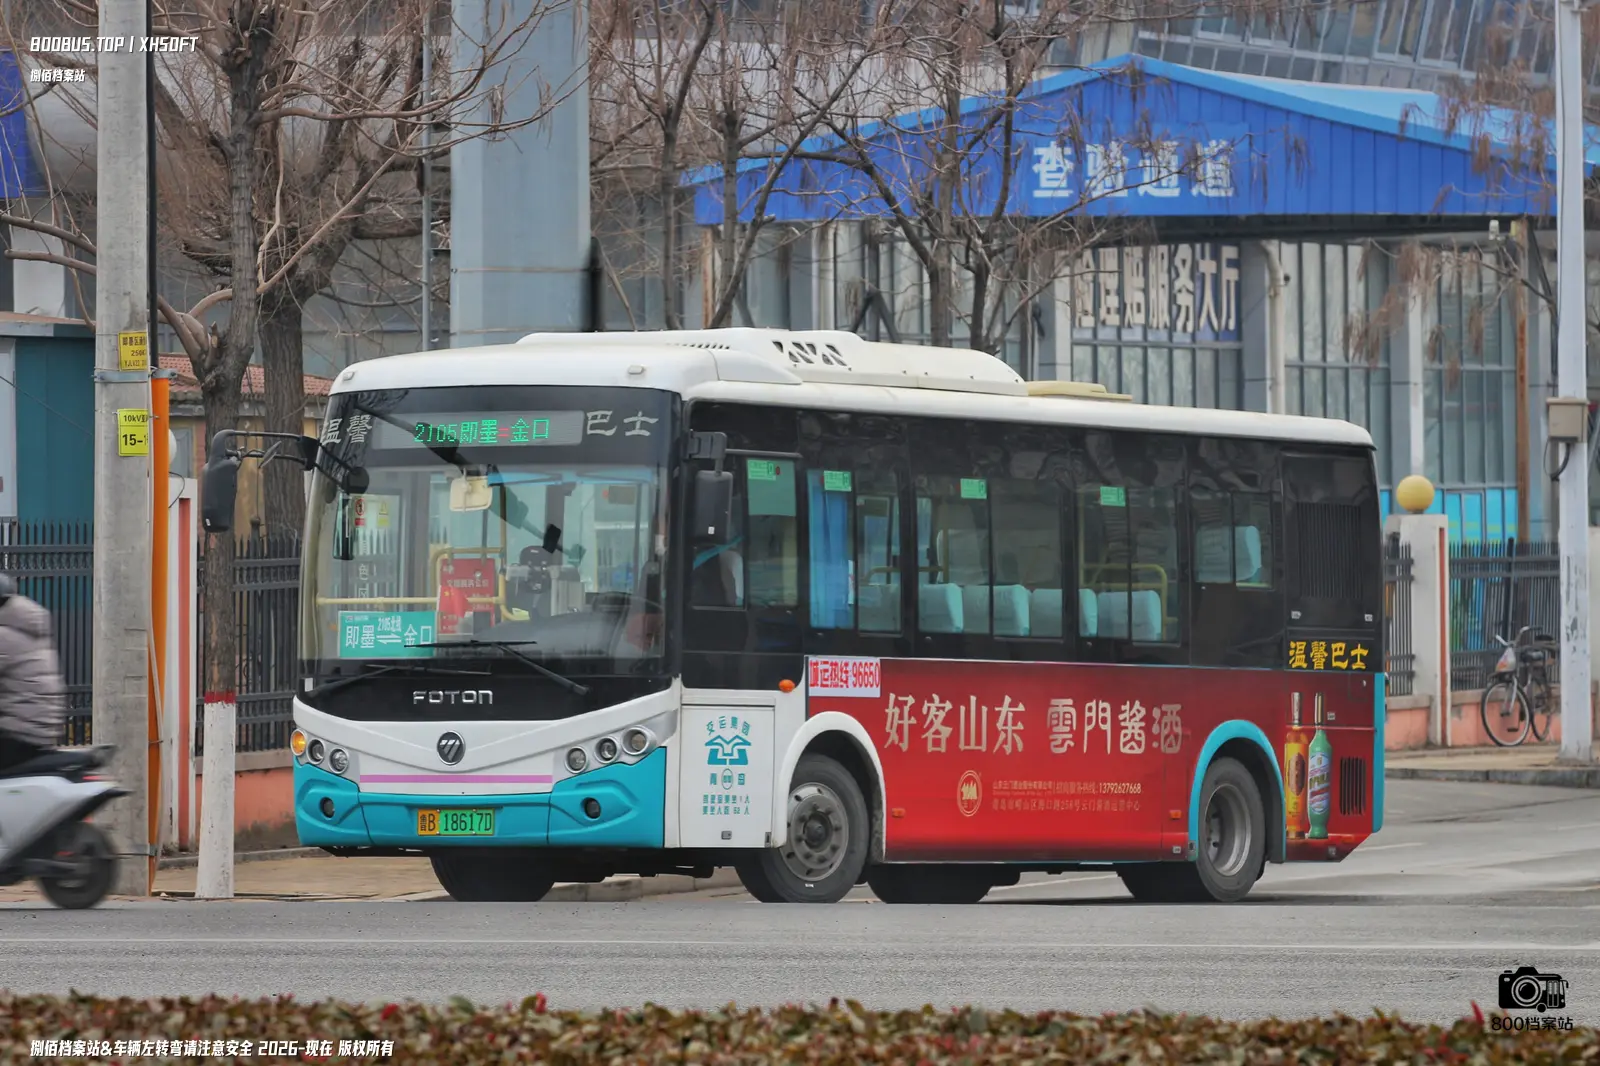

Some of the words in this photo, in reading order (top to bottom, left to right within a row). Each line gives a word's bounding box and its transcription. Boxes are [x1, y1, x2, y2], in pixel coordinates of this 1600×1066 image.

[1032, 140, 1235, 198] 查验通道
[586, 410, 660, 437] 巴士
[345, 624, 375, 649] 即墨
[403, 623, 432, 648] 金口
[1289, 640, 1370, 671] 温馨巴士
[413, 690, 493, 705] FOTON
[883, 692, 1026, 756] 好客山东
